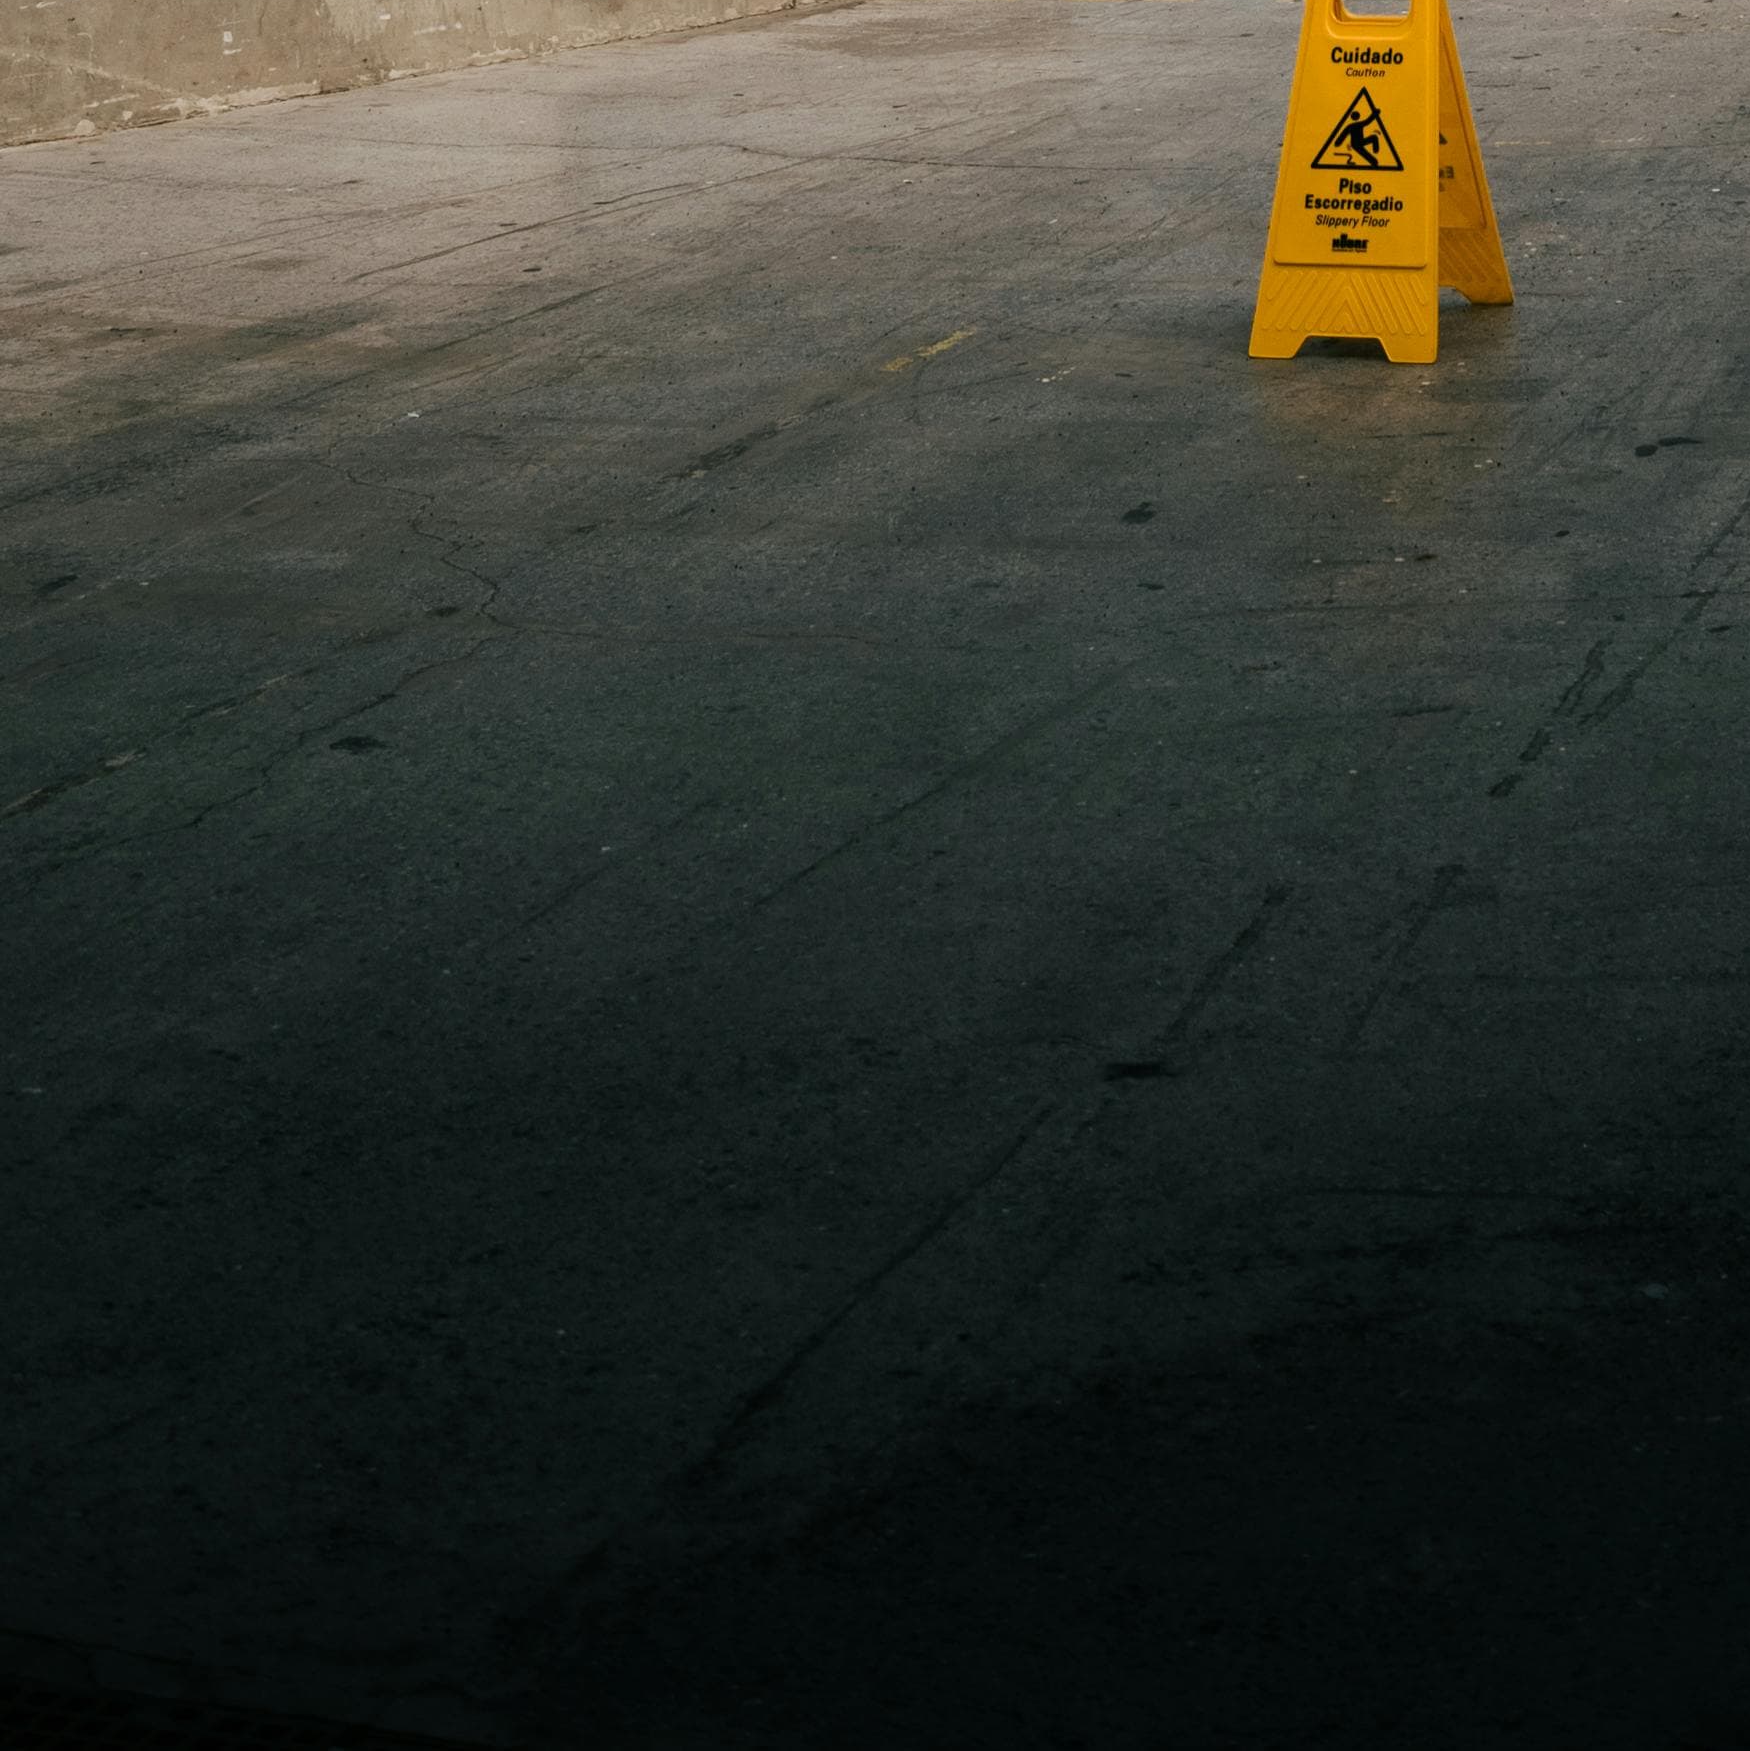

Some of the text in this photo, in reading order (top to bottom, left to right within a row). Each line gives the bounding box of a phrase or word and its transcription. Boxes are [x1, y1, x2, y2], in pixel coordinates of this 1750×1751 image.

[1331, 46, 1403, 65] Cuidado
[1345, 67, 1386, 78] Caution
[1339, 178, 1372, 195] Piso
[1305, 194, 1403, 214] Escorregadio
[1315, 214, 1390, 229] Slippery Floor
